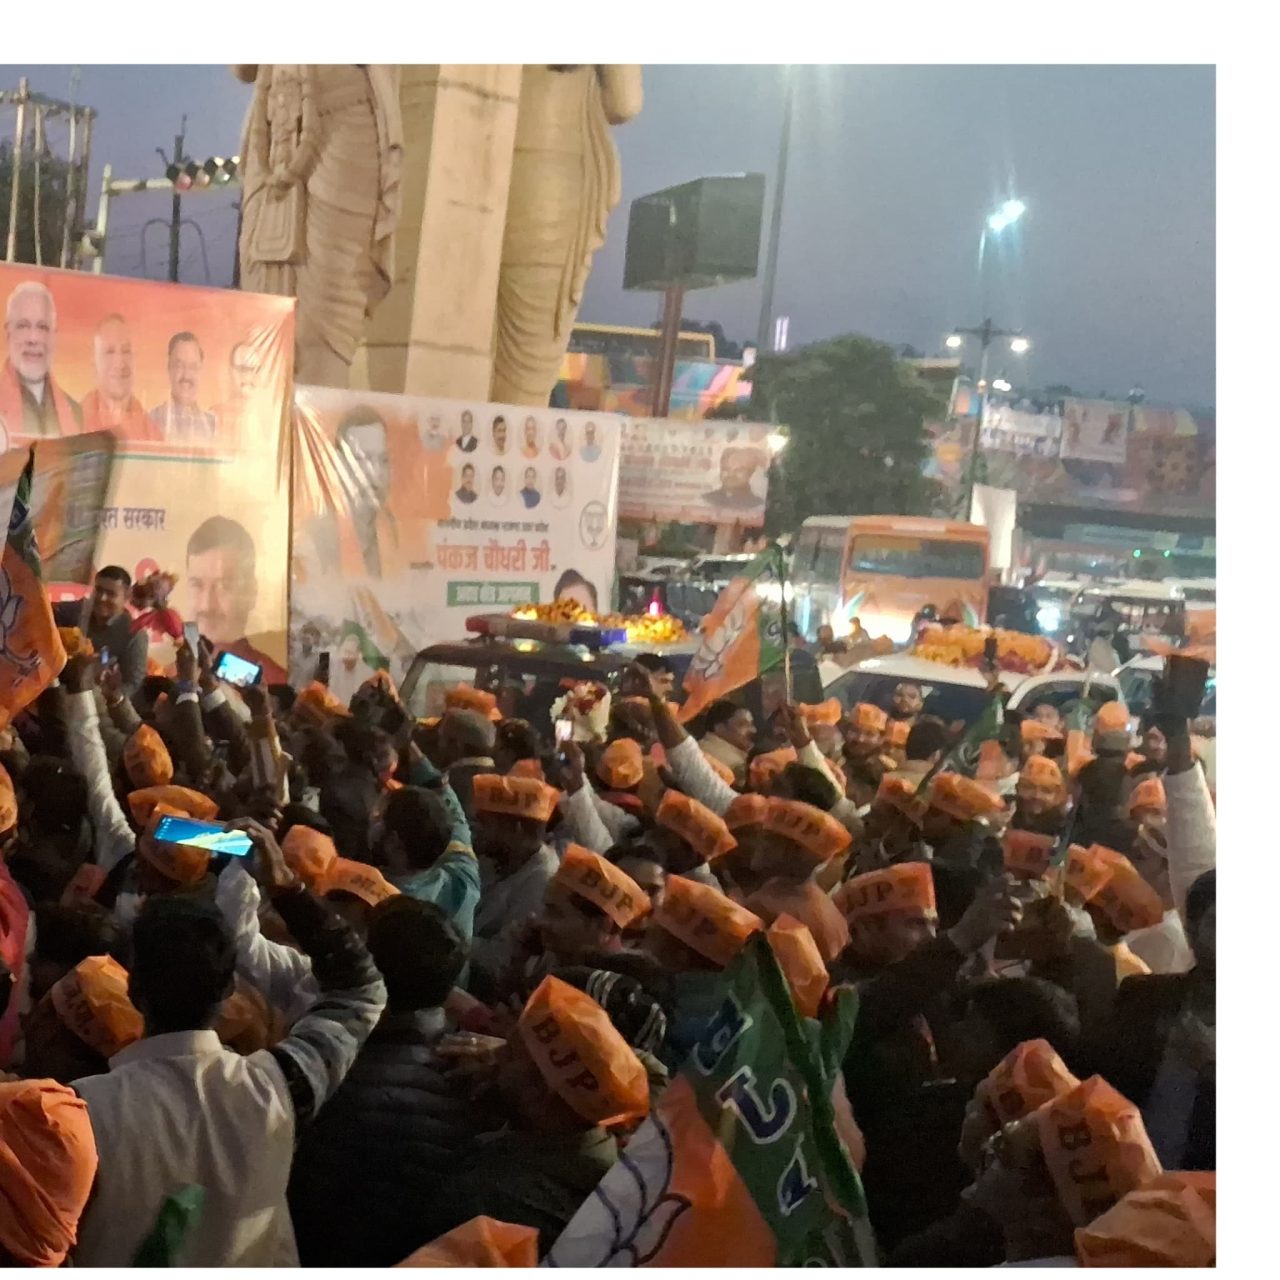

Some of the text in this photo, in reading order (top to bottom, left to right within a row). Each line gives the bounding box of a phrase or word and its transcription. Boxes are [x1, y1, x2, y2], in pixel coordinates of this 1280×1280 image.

[123, 507, 166, 530] सरकार
[436, 537, 480, 571] पंकज
[483, 537, 528, 572] चौधरी
[531, 1017, 600, 1094] BJP
[1057, 1115, 1111, 1186] BJ
